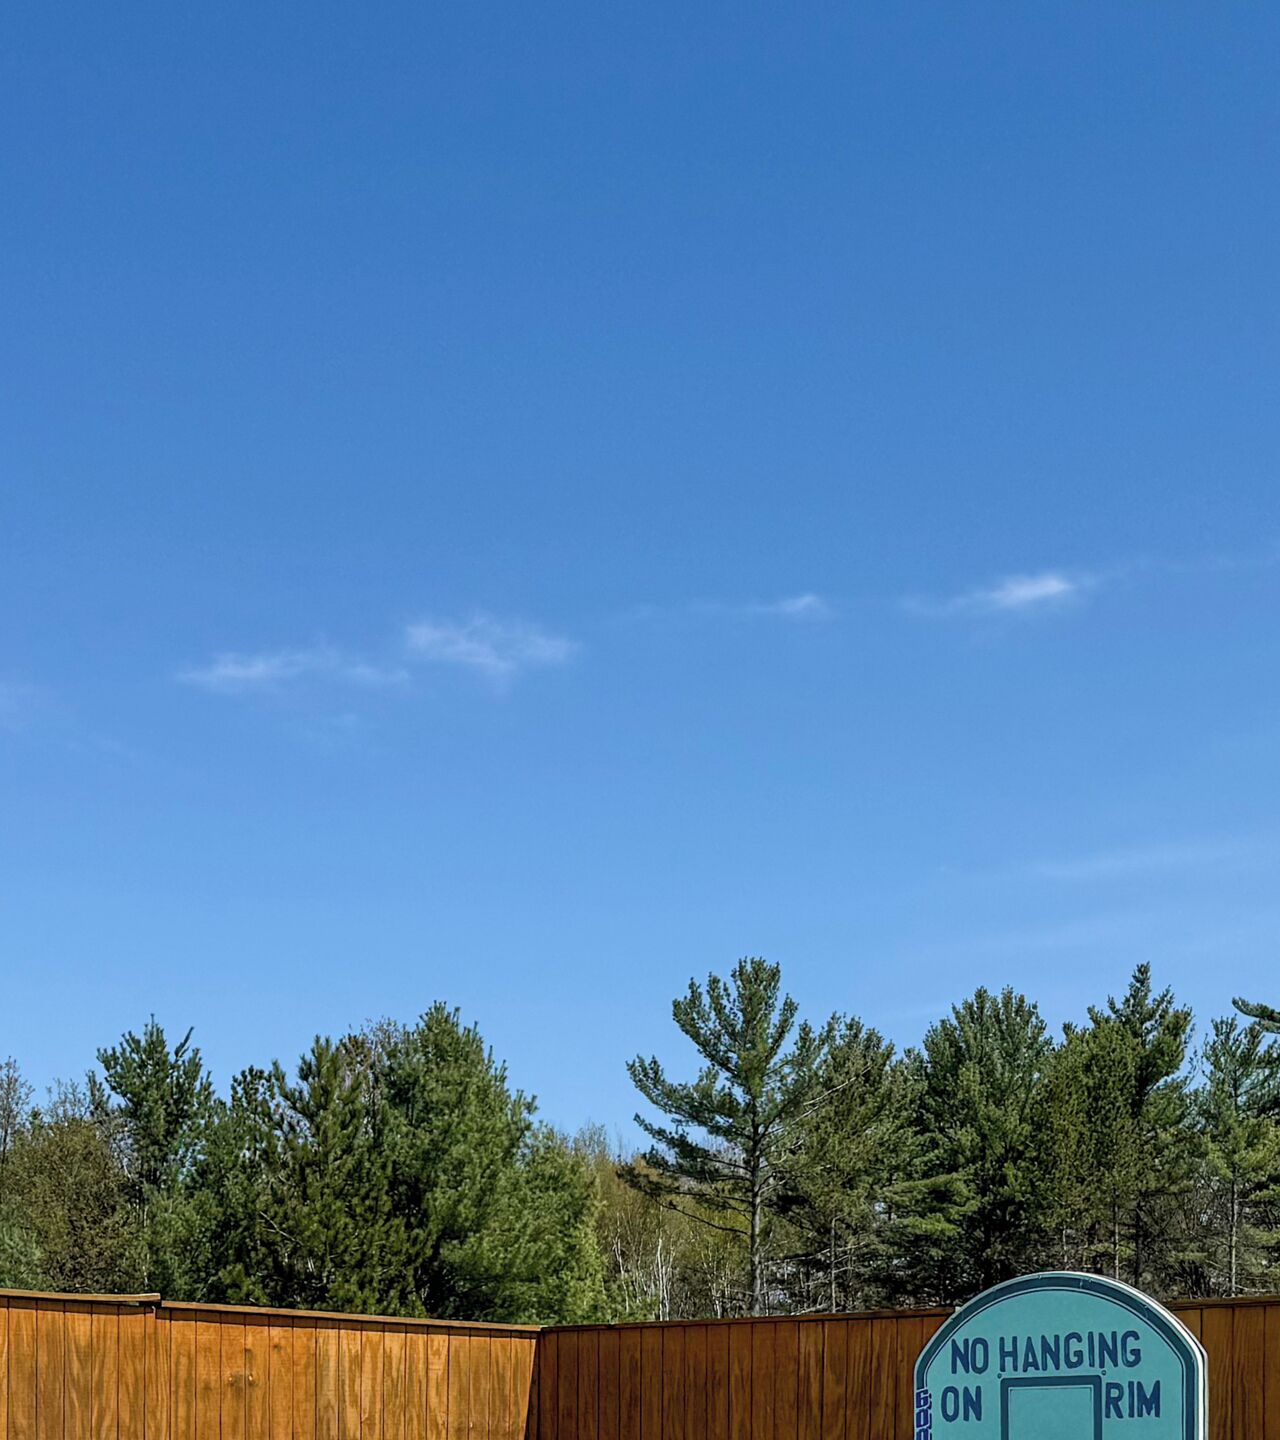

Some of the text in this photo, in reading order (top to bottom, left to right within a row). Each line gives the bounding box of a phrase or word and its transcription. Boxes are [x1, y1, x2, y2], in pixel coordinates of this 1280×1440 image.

[951, 1330, 1141, 1375] NO HANGING
[940, 1380, 1161, 1422] ON RIM
